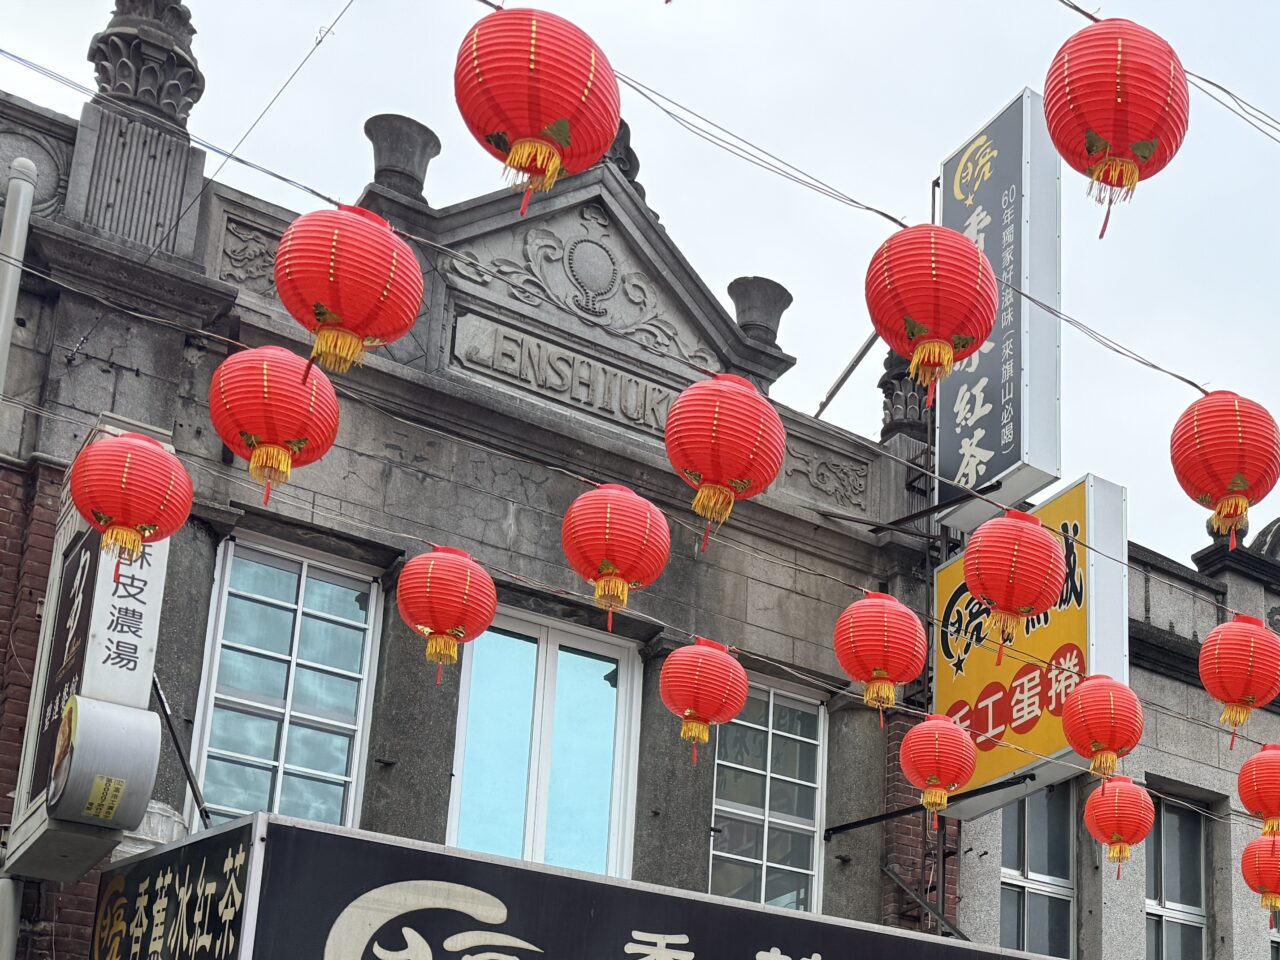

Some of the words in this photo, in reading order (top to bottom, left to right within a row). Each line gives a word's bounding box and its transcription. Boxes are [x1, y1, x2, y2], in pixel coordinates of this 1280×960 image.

[465, 325, 675, 432] LENSHIUK
[953, 204, 995, 490] 香紅茶
